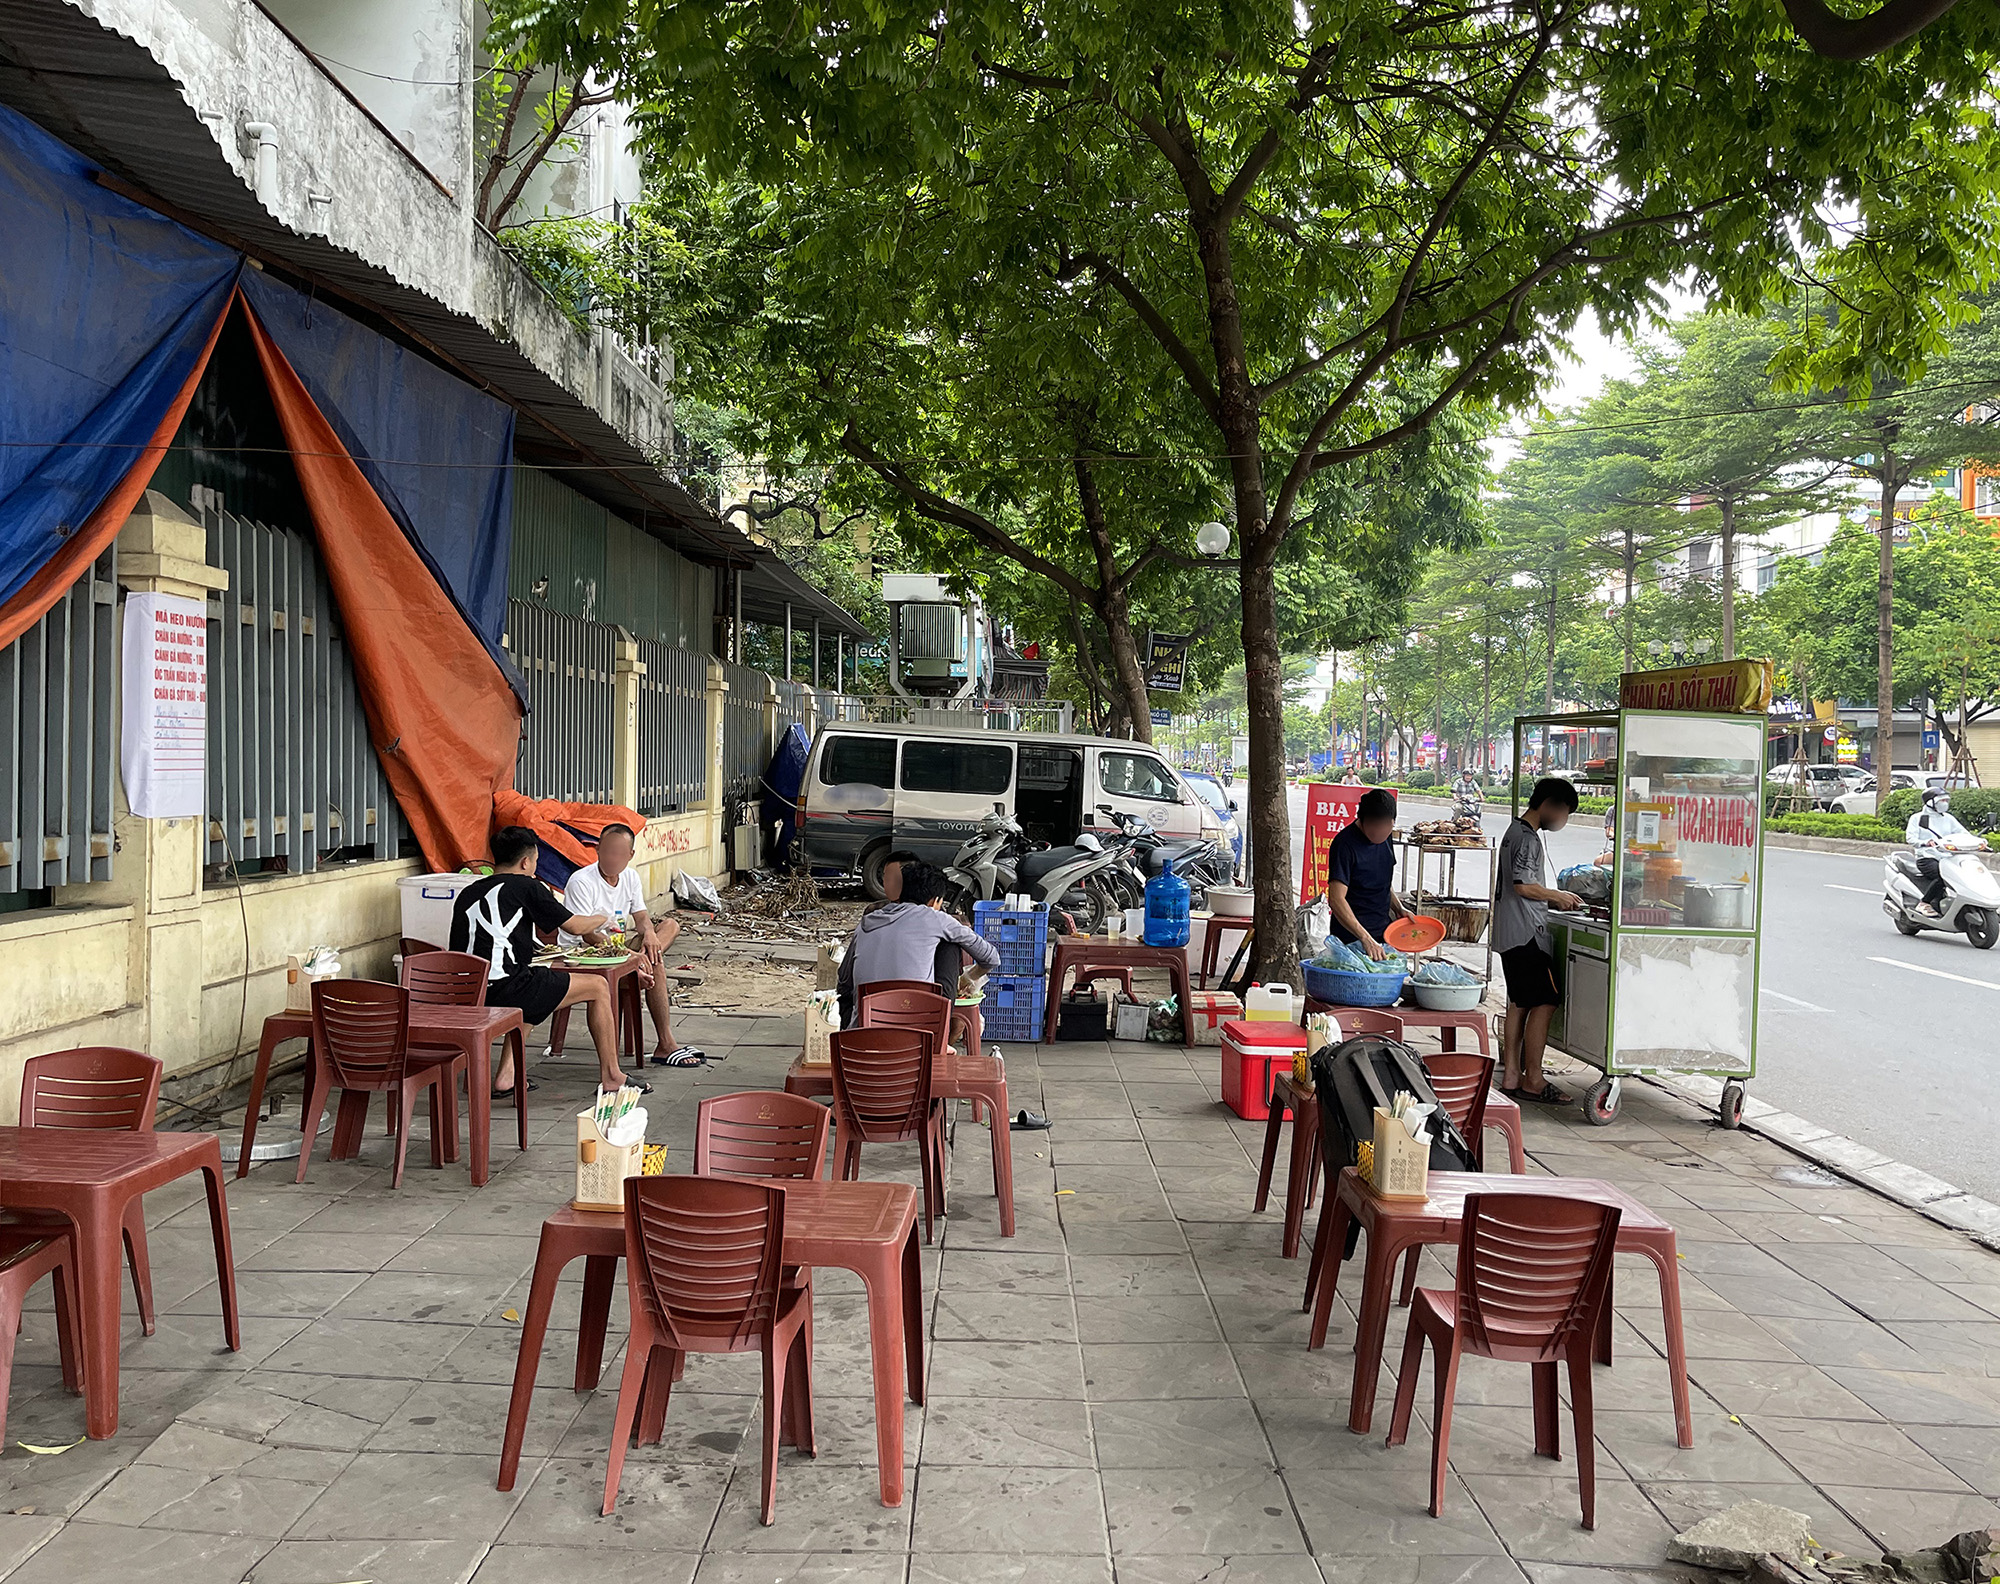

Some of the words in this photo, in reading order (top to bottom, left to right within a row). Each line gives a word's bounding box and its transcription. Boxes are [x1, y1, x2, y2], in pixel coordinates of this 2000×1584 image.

[170, 612, 184, 626] HEO
[170, 630, 176, 643] GÀ
[170, 648, 176, 662] GÀ
[170, 687, 176, 700] GÀ
[1622, 680, 1654, 709] CHÂN
[1657, 676, 1675, 709] GÀ
[1678, 669, 1704, 709] SỐT
[1705, 669, 1738, 707] THÁI
[1316, 801, 1349, 818] BIA
[937, 821, 975, 832] TOYOTA
